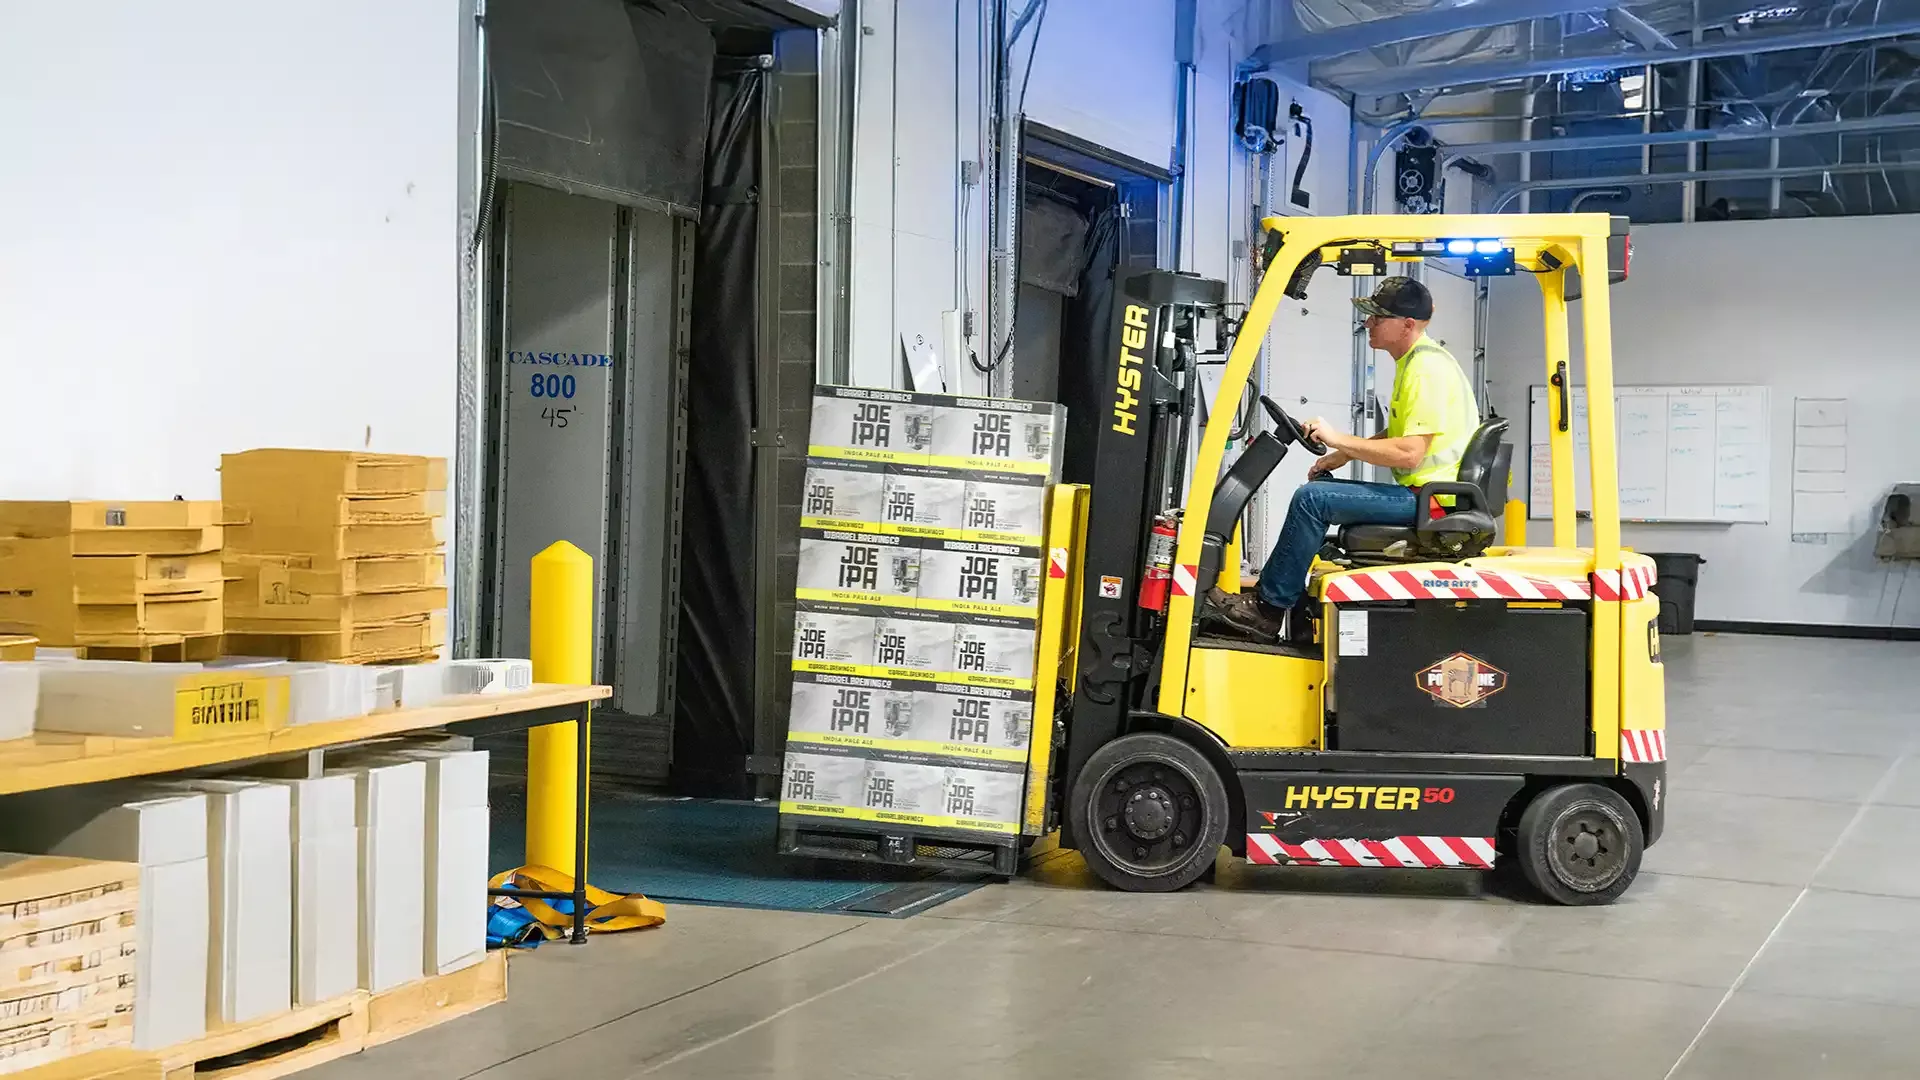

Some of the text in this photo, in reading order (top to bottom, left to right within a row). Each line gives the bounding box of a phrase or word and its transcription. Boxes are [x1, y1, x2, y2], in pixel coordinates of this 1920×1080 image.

[508, 351, 613, 367] CASCADE
[1112, 304, 1149, 436] HYSTER
[530, 373, 576, 398] 800
[853, 403, 892, 424] JOE
[973, 412, 1012, 433] JOE
[851, 422, 890, 447] IPA
[972, 432, 1010, 457] IPA
[808, 485, 835, 498] JOE
[889, 491, 915, 505] JOE
[807, 498, 833, 515] IPA
[887, 505, 914, 521] IPA
[970, 499, 996, 512] JOE
[968, 512, 995, 529] IPA
[841, 546, 879, 566] JOE
[961, 556, 999, 576] JOE
[839, 564, 878, 590] IPA
[959, 575, 998, 600] IPA
[800, 629, 826, 642] JOE
[880, 635, 906, 649] JOE
[798, 642, 825, 659] IPA
[878, 648, 905, 665] IPA
[960, 641, 986, 655] JOE
[958, 654, 985, 671] IPA
[833, 689, 871, 709] JOE
[953, 699, 991, 719] JOE
[830, 708, 869, 733] IPA
[950, 717, 989, 743] IPA
[789, 770, 815, 783] JOE
[868, 777, 895, 791] JOE
[787, 783, 814, 800] IPA
[866, 790, 893, 808] IPA
[949, 784, 975, 799] JOE
[1284, 786, 1455, 811] HYSTER 50
[947, 798, 974, 815] IPA
